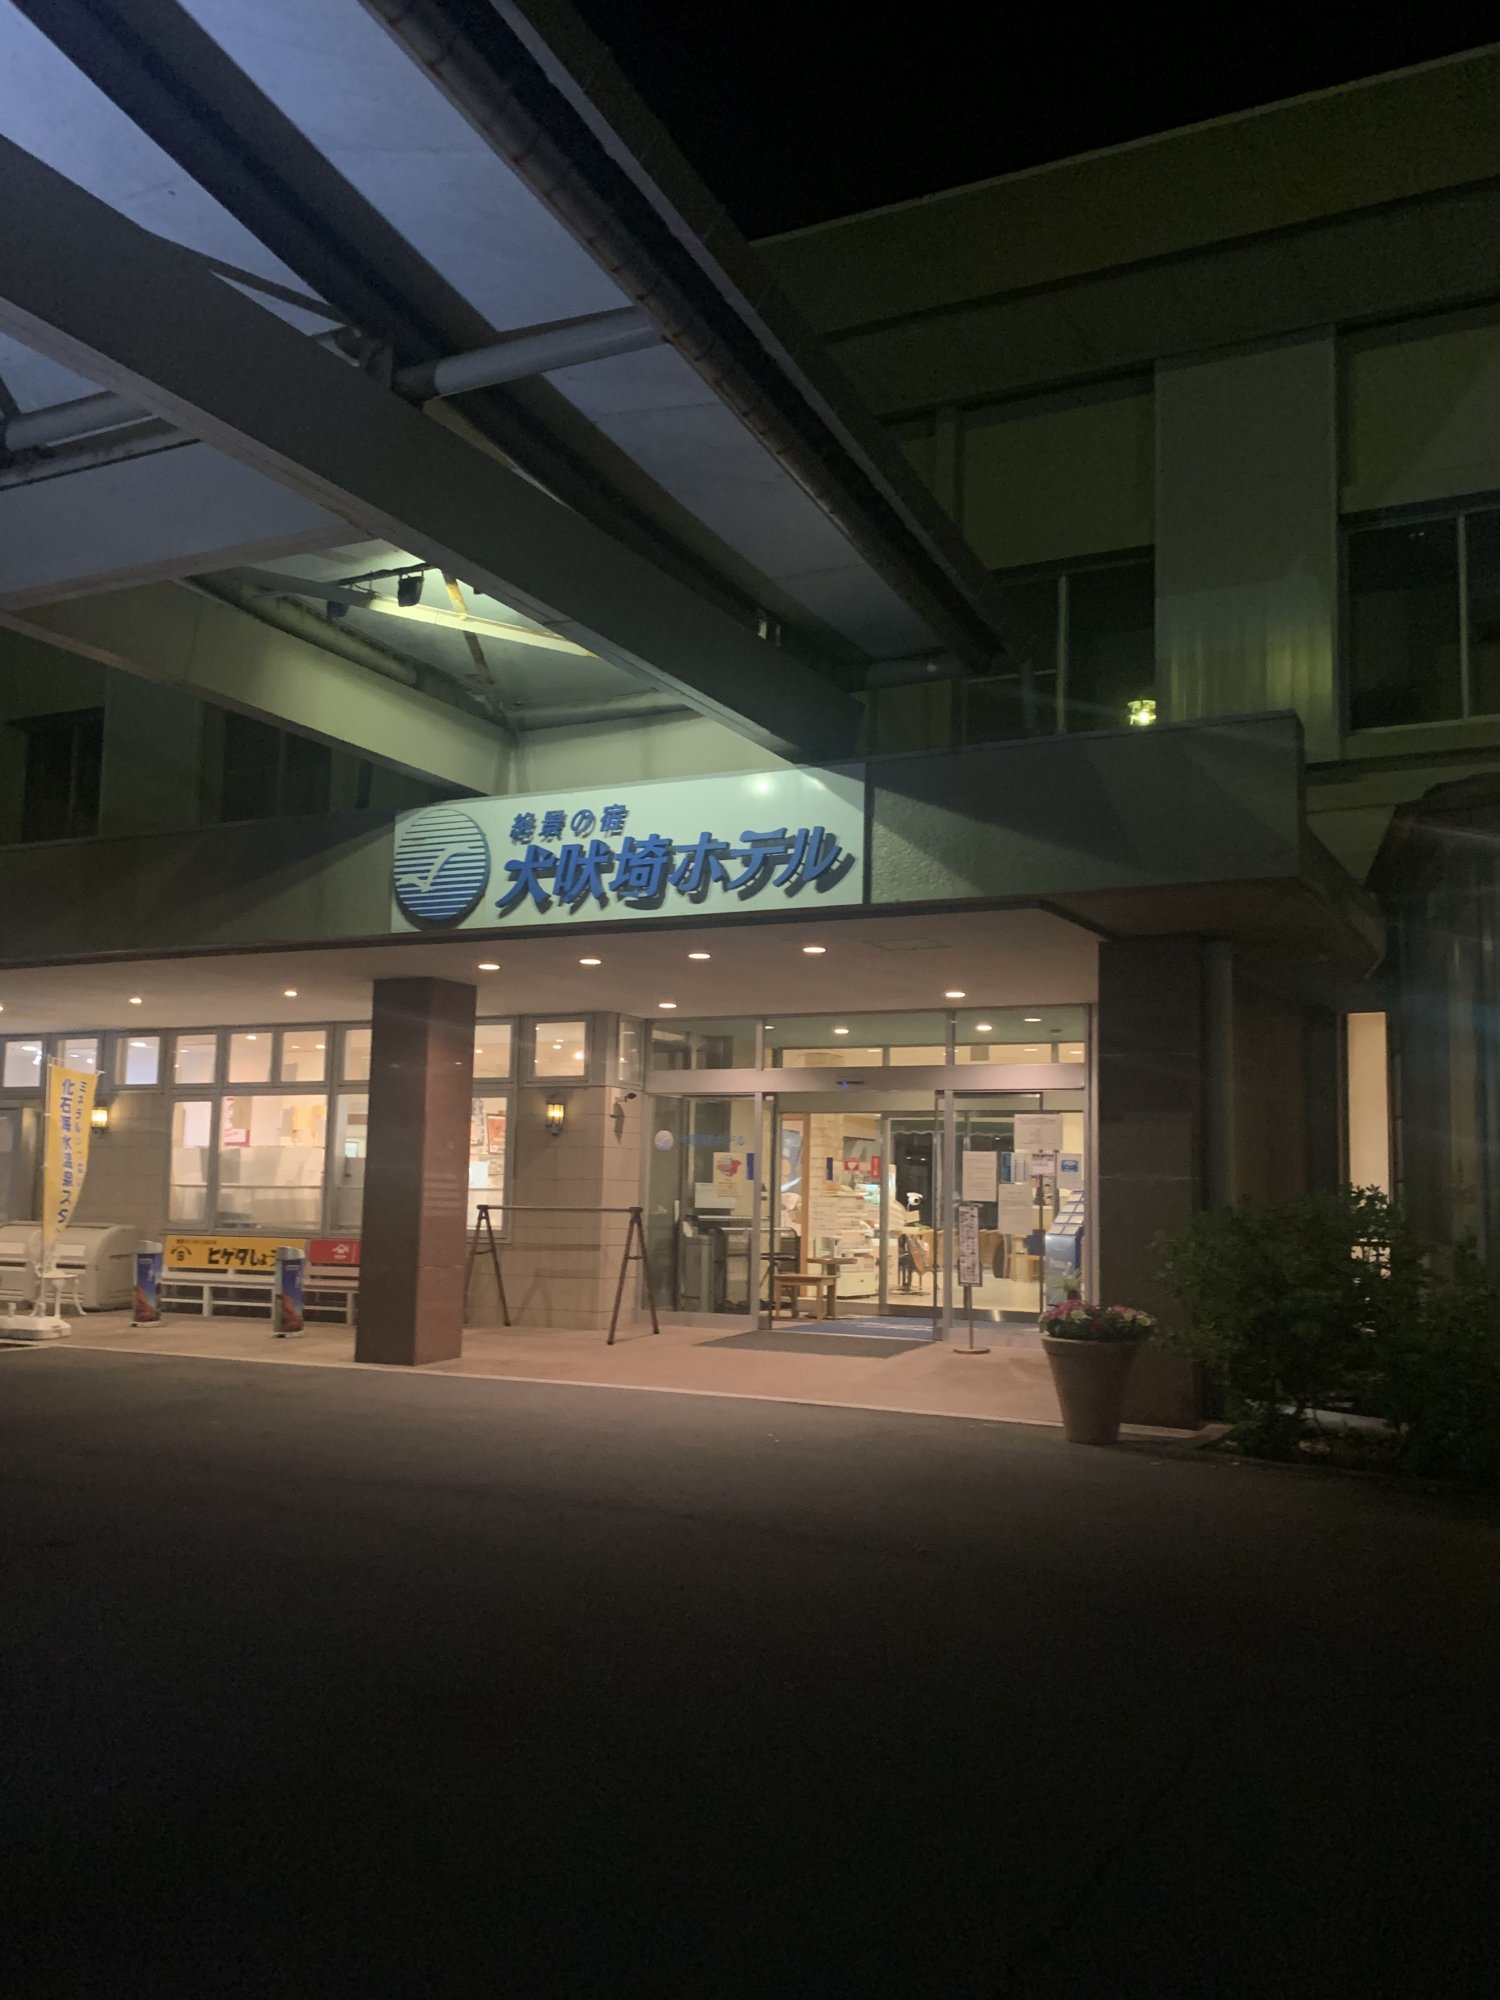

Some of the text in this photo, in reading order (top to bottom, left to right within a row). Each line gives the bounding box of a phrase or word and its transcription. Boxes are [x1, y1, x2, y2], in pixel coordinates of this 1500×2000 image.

[509, 804, 627, 841] 絶景の宿
[496, 826, 843, 909] 犬吠埼ホテル
